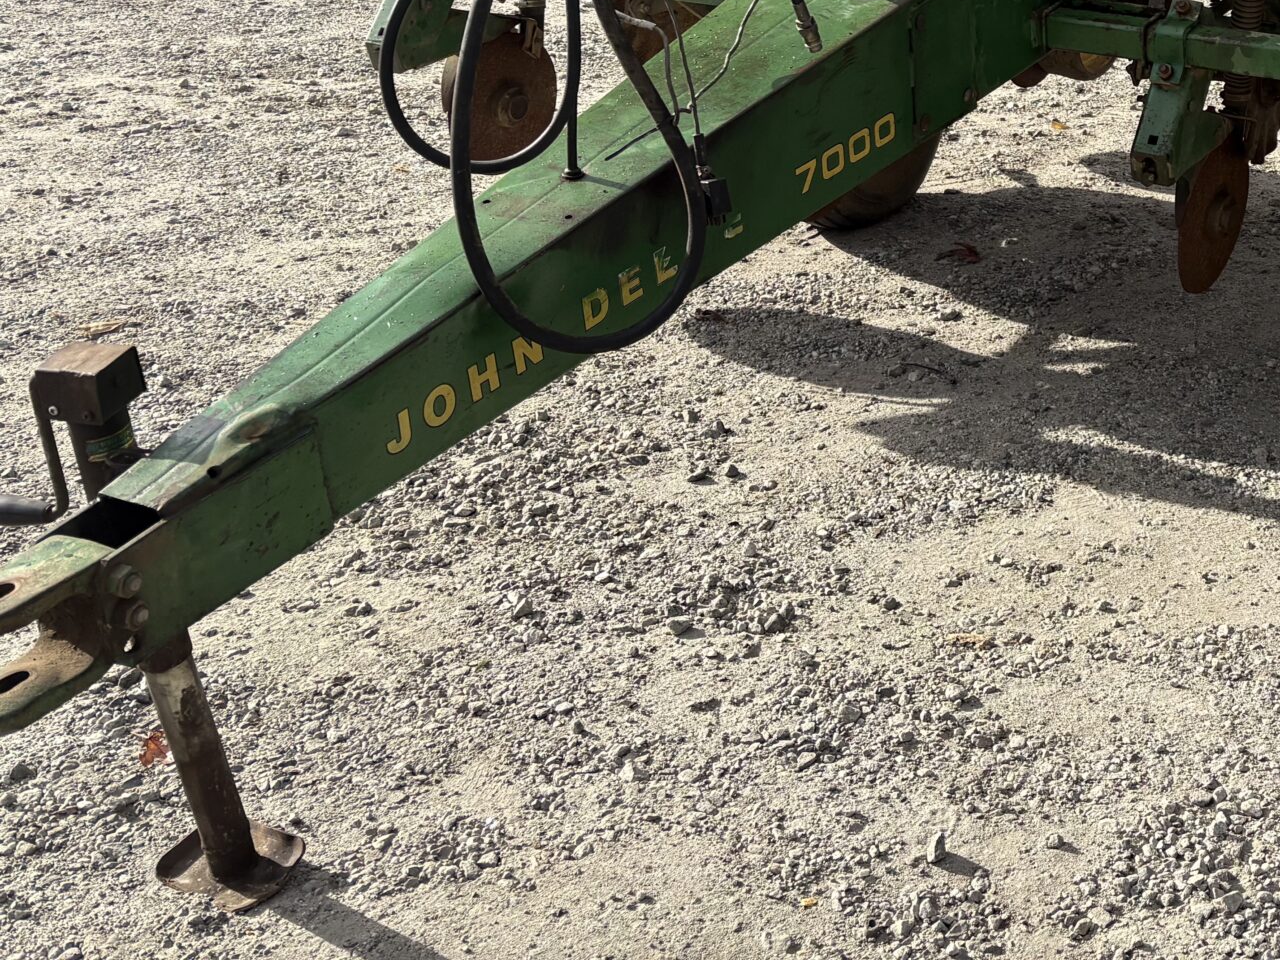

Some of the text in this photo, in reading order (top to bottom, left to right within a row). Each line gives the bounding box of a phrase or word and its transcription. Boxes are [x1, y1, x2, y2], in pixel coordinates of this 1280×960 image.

[795, 112, 897, 195] 7000
[385, 212, 745, 456] JOHN DEE
